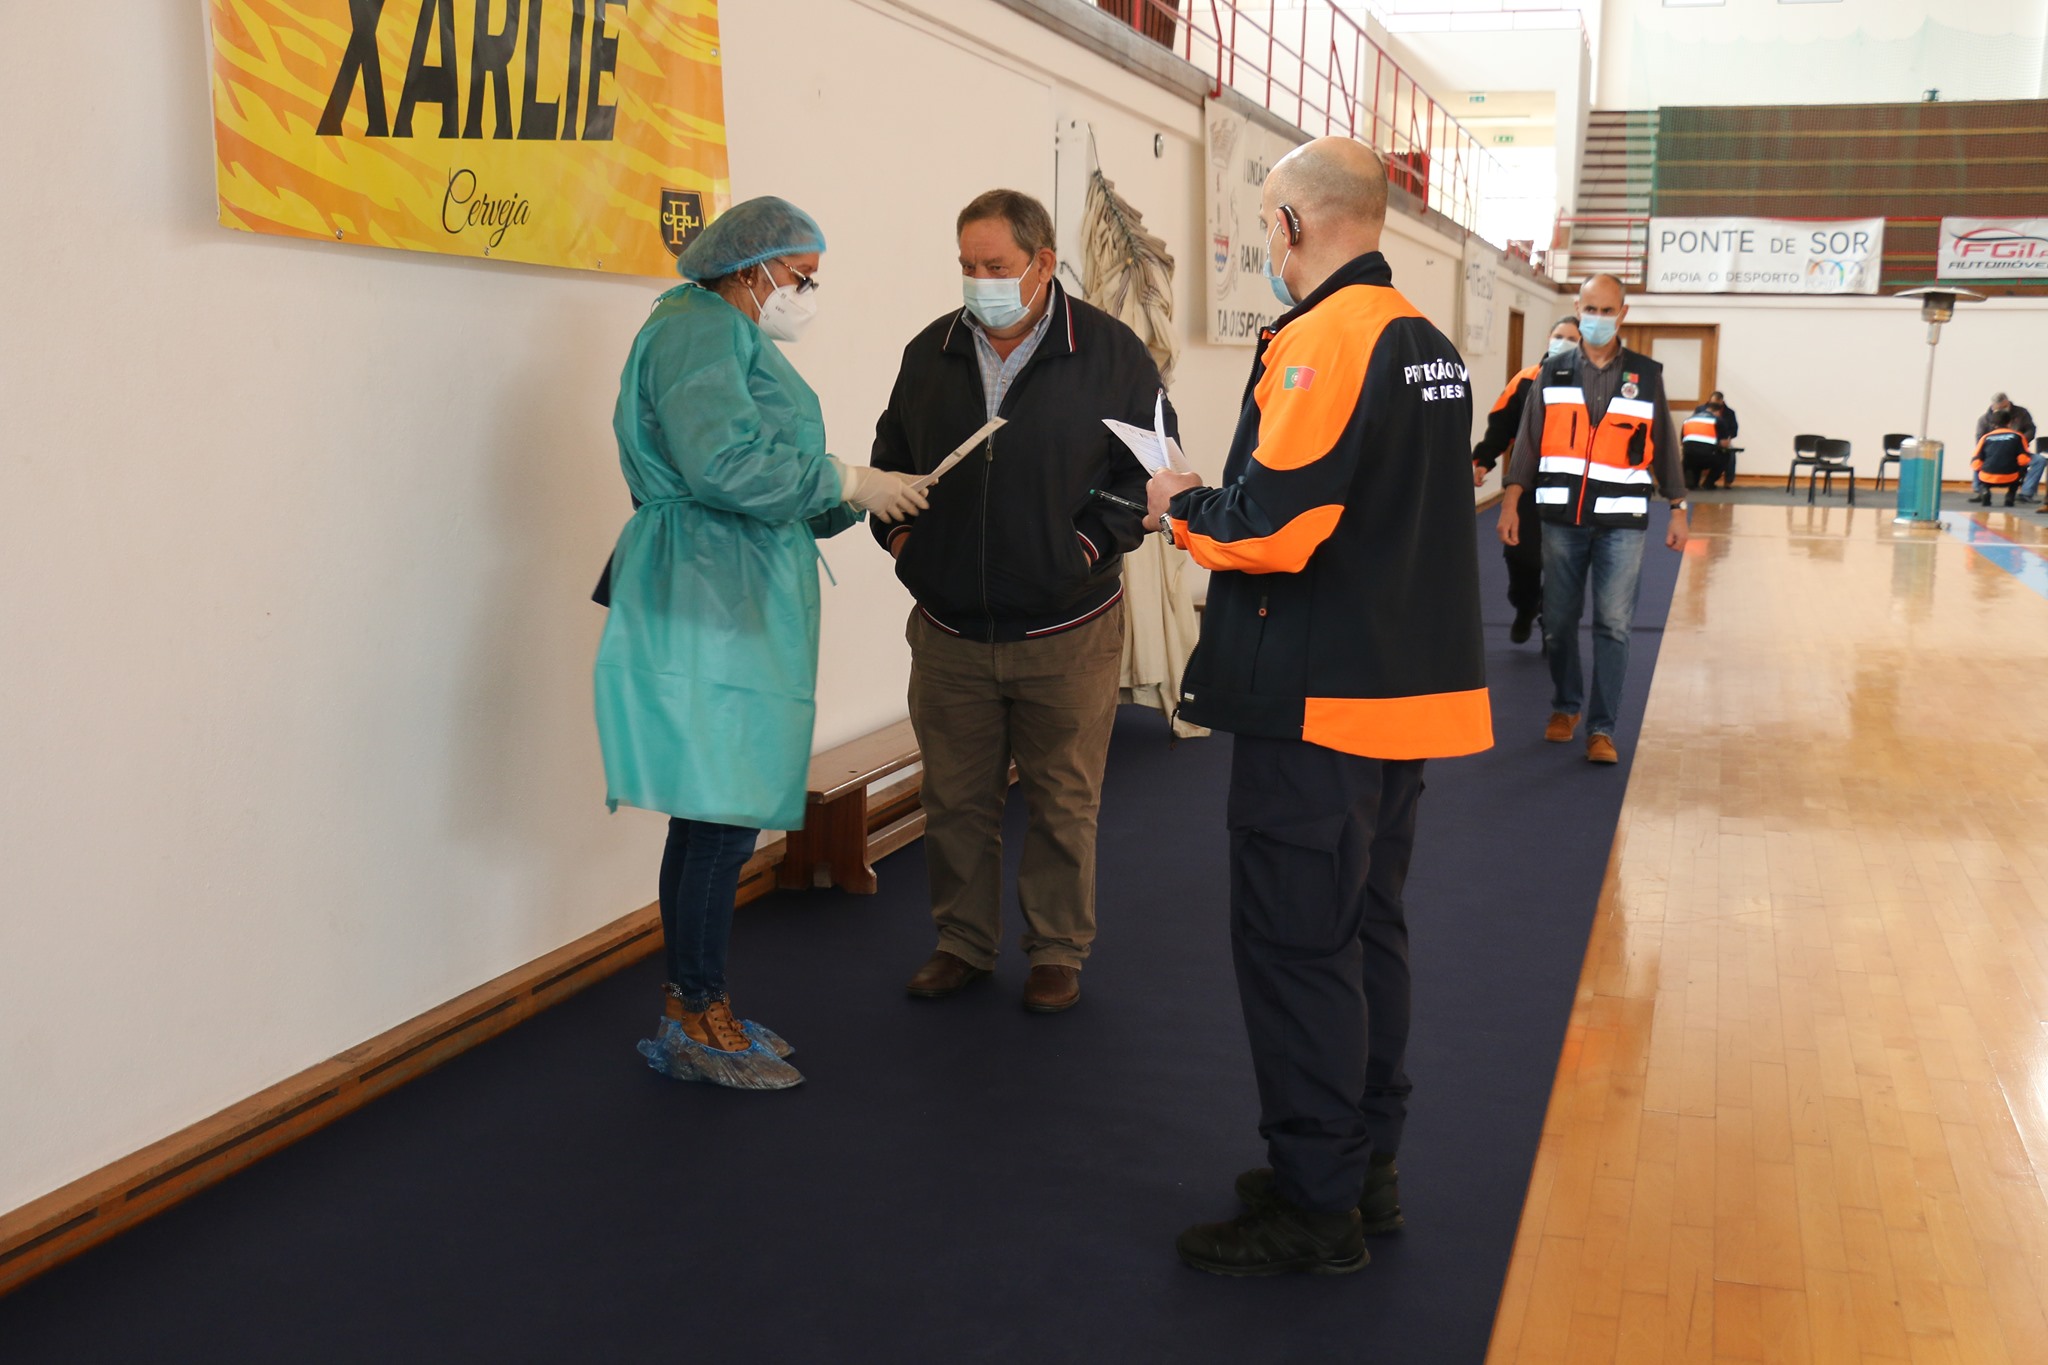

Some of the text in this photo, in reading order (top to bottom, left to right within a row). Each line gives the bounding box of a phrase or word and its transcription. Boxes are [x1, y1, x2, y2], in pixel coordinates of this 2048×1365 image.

[315, 0, 628, 141] XARLIE
[442, 167, 531, 248] Cerveja
[1660, 230, 1869, 255] PONTE DE SOR
[1661, 271, 1701, 283] APOIA
[1708, 272, 1719, 283] O
[1726, 271, 1800, 284] DESPORTO
